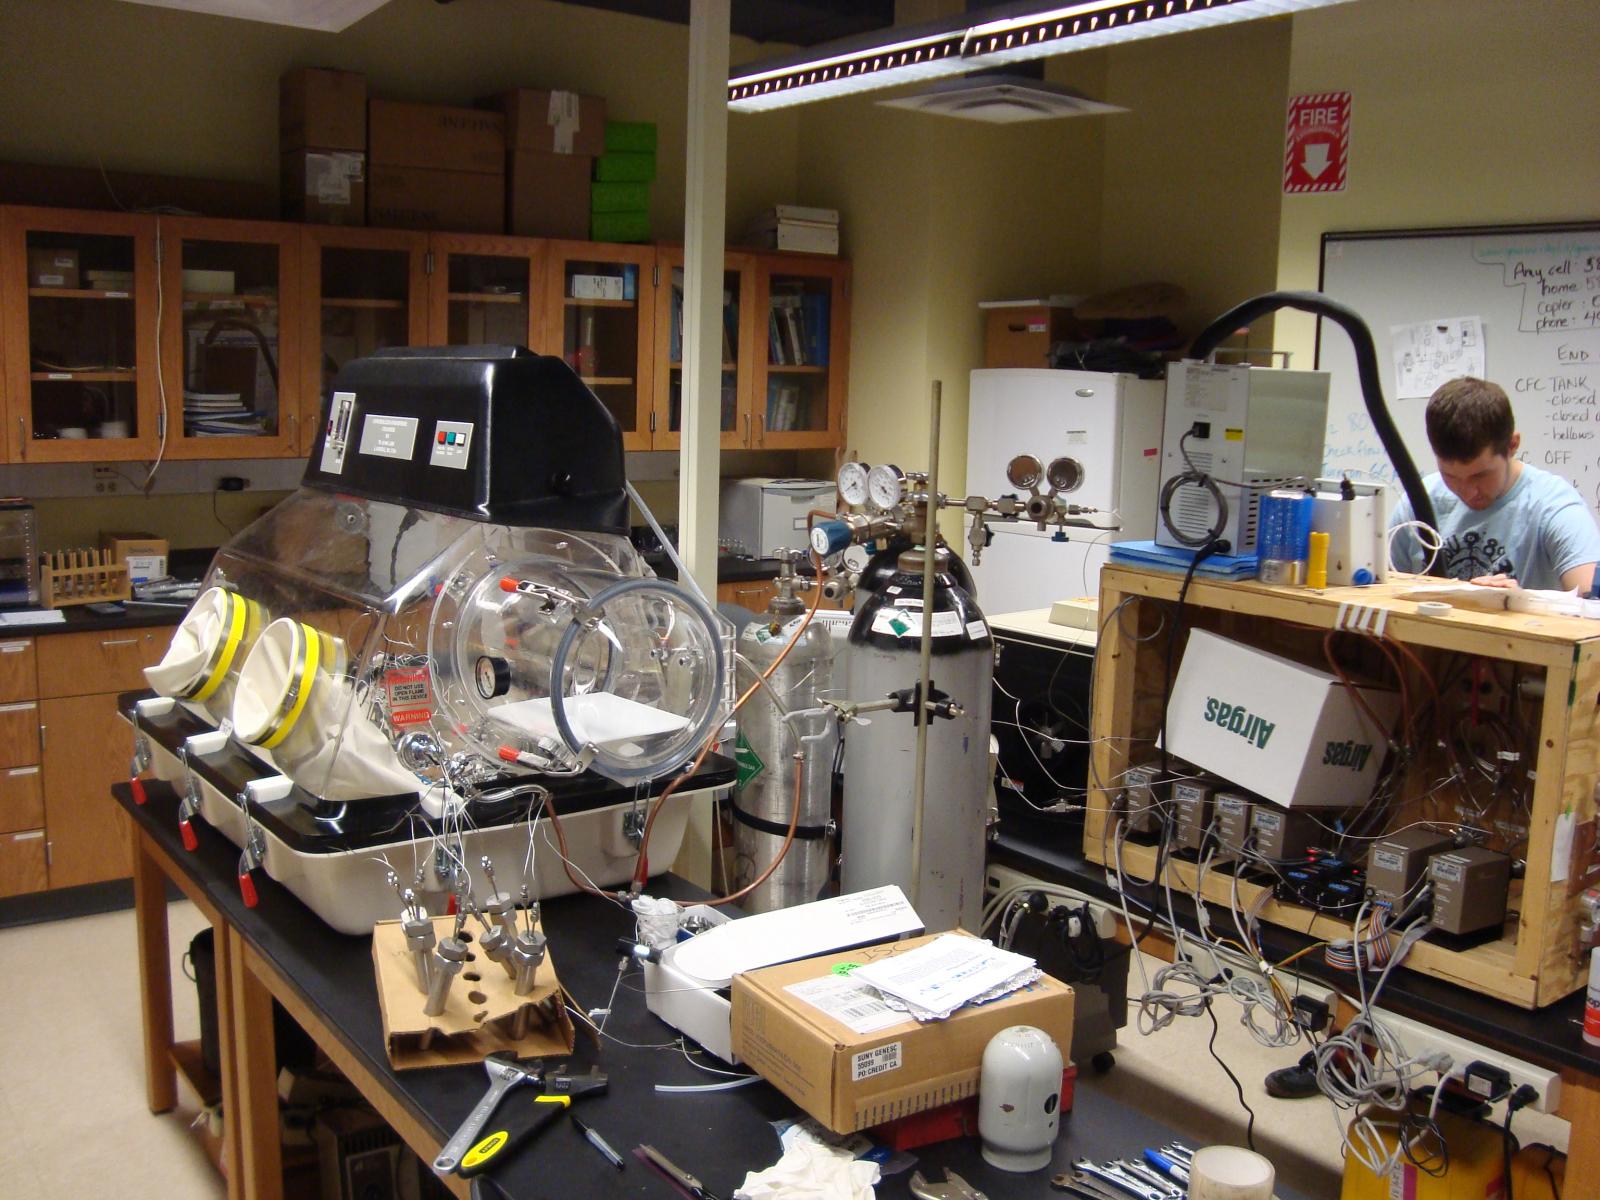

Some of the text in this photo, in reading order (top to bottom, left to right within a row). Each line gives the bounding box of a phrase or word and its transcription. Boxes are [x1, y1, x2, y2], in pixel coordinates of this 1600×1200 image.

[1299, 106, 1339, 127] FIRE
[1557, 344, 1590, 361] END
[1515, 375, 1591, 393] CFC TANK
[1544, 450, 1573, 465] OFF
[393, 711, 430, 722] WARNING
[1322, 739, 1373, 772] Airgas
[857, 1044, 897, 1062] SUNY GENESC
